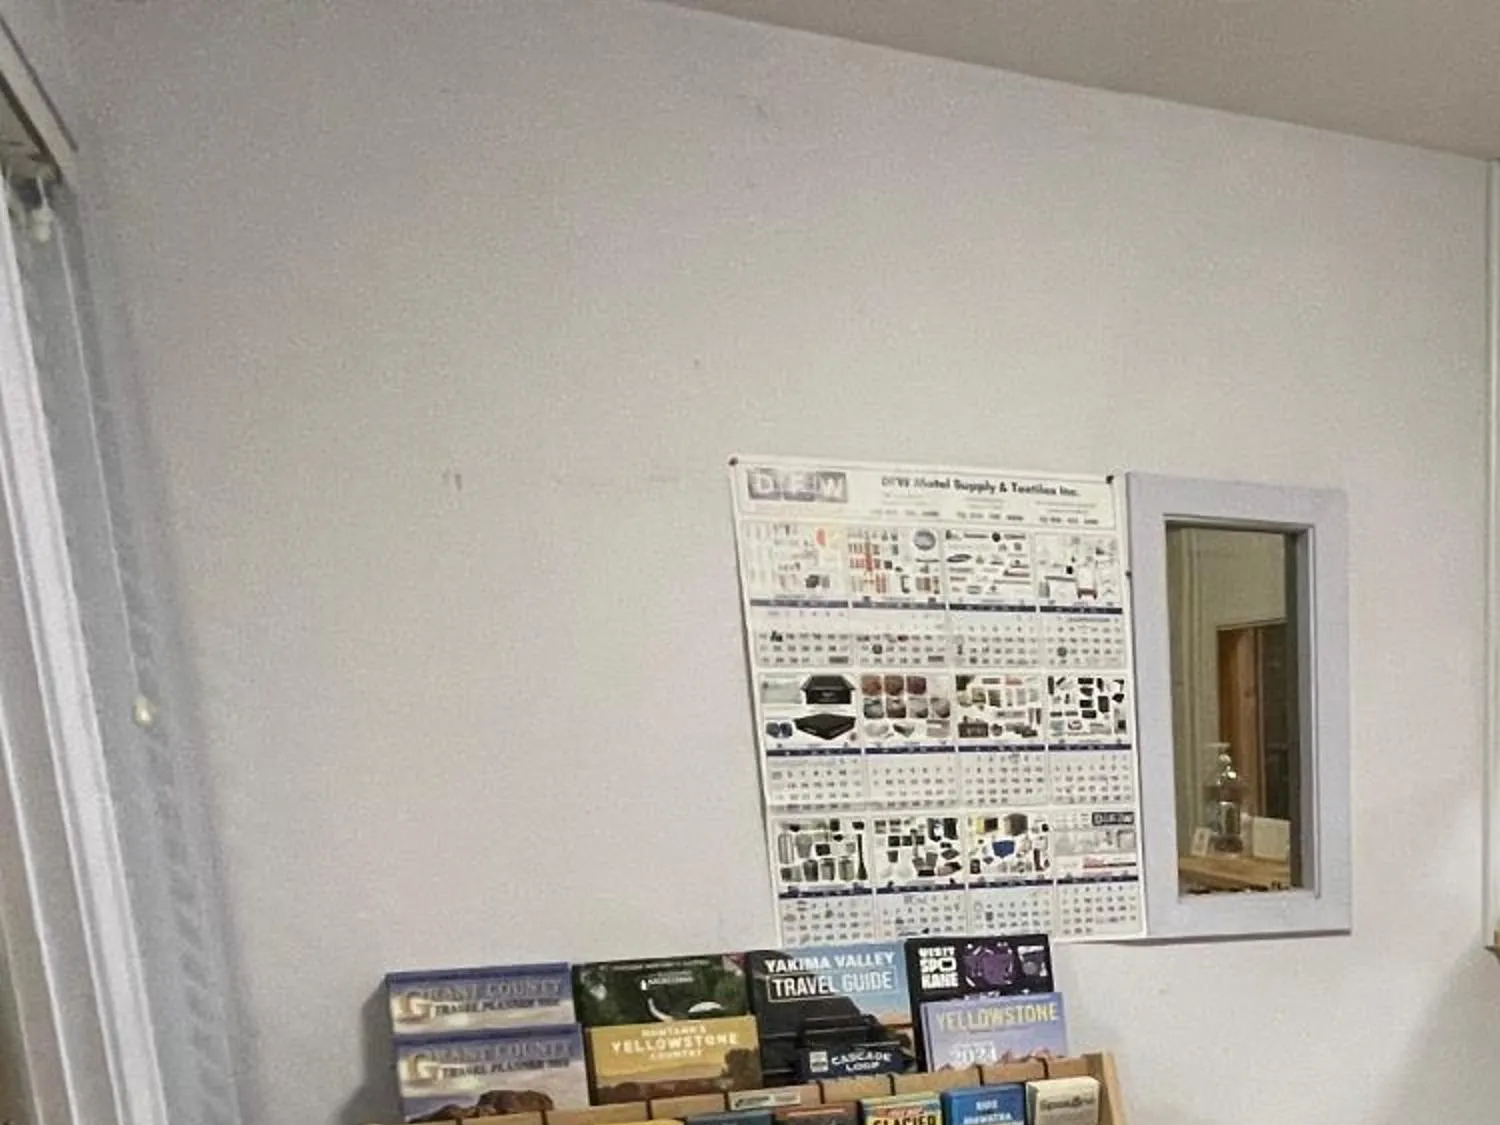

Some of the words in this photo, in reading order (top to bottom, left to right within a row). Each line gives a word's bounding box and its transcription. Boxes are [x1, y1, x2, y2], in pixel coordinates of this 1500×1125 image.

[953, 479, 996, 494] Supply
[919, 947, 955, 957] VISIT
[764, 956, 831, 973] YAKIMA
[833, 951, 895, 969] VALLEY
[919, 957, 957, 973] SPO
[487, 978, 562, 997] COUNTY
[772, 974, 840, 997] TRAVEL
[841, 970, 893, 993] GUIDE
[921, 973, 958, 989] KANE
[936, 1002, 1058, 1032] YELLOWSTONE
[611, 1032, 740, 1054] YELLOWSTONE
[831, 1051, 892, 1066] CASCADE
[845, 1061, 881, 1072] LOOP
